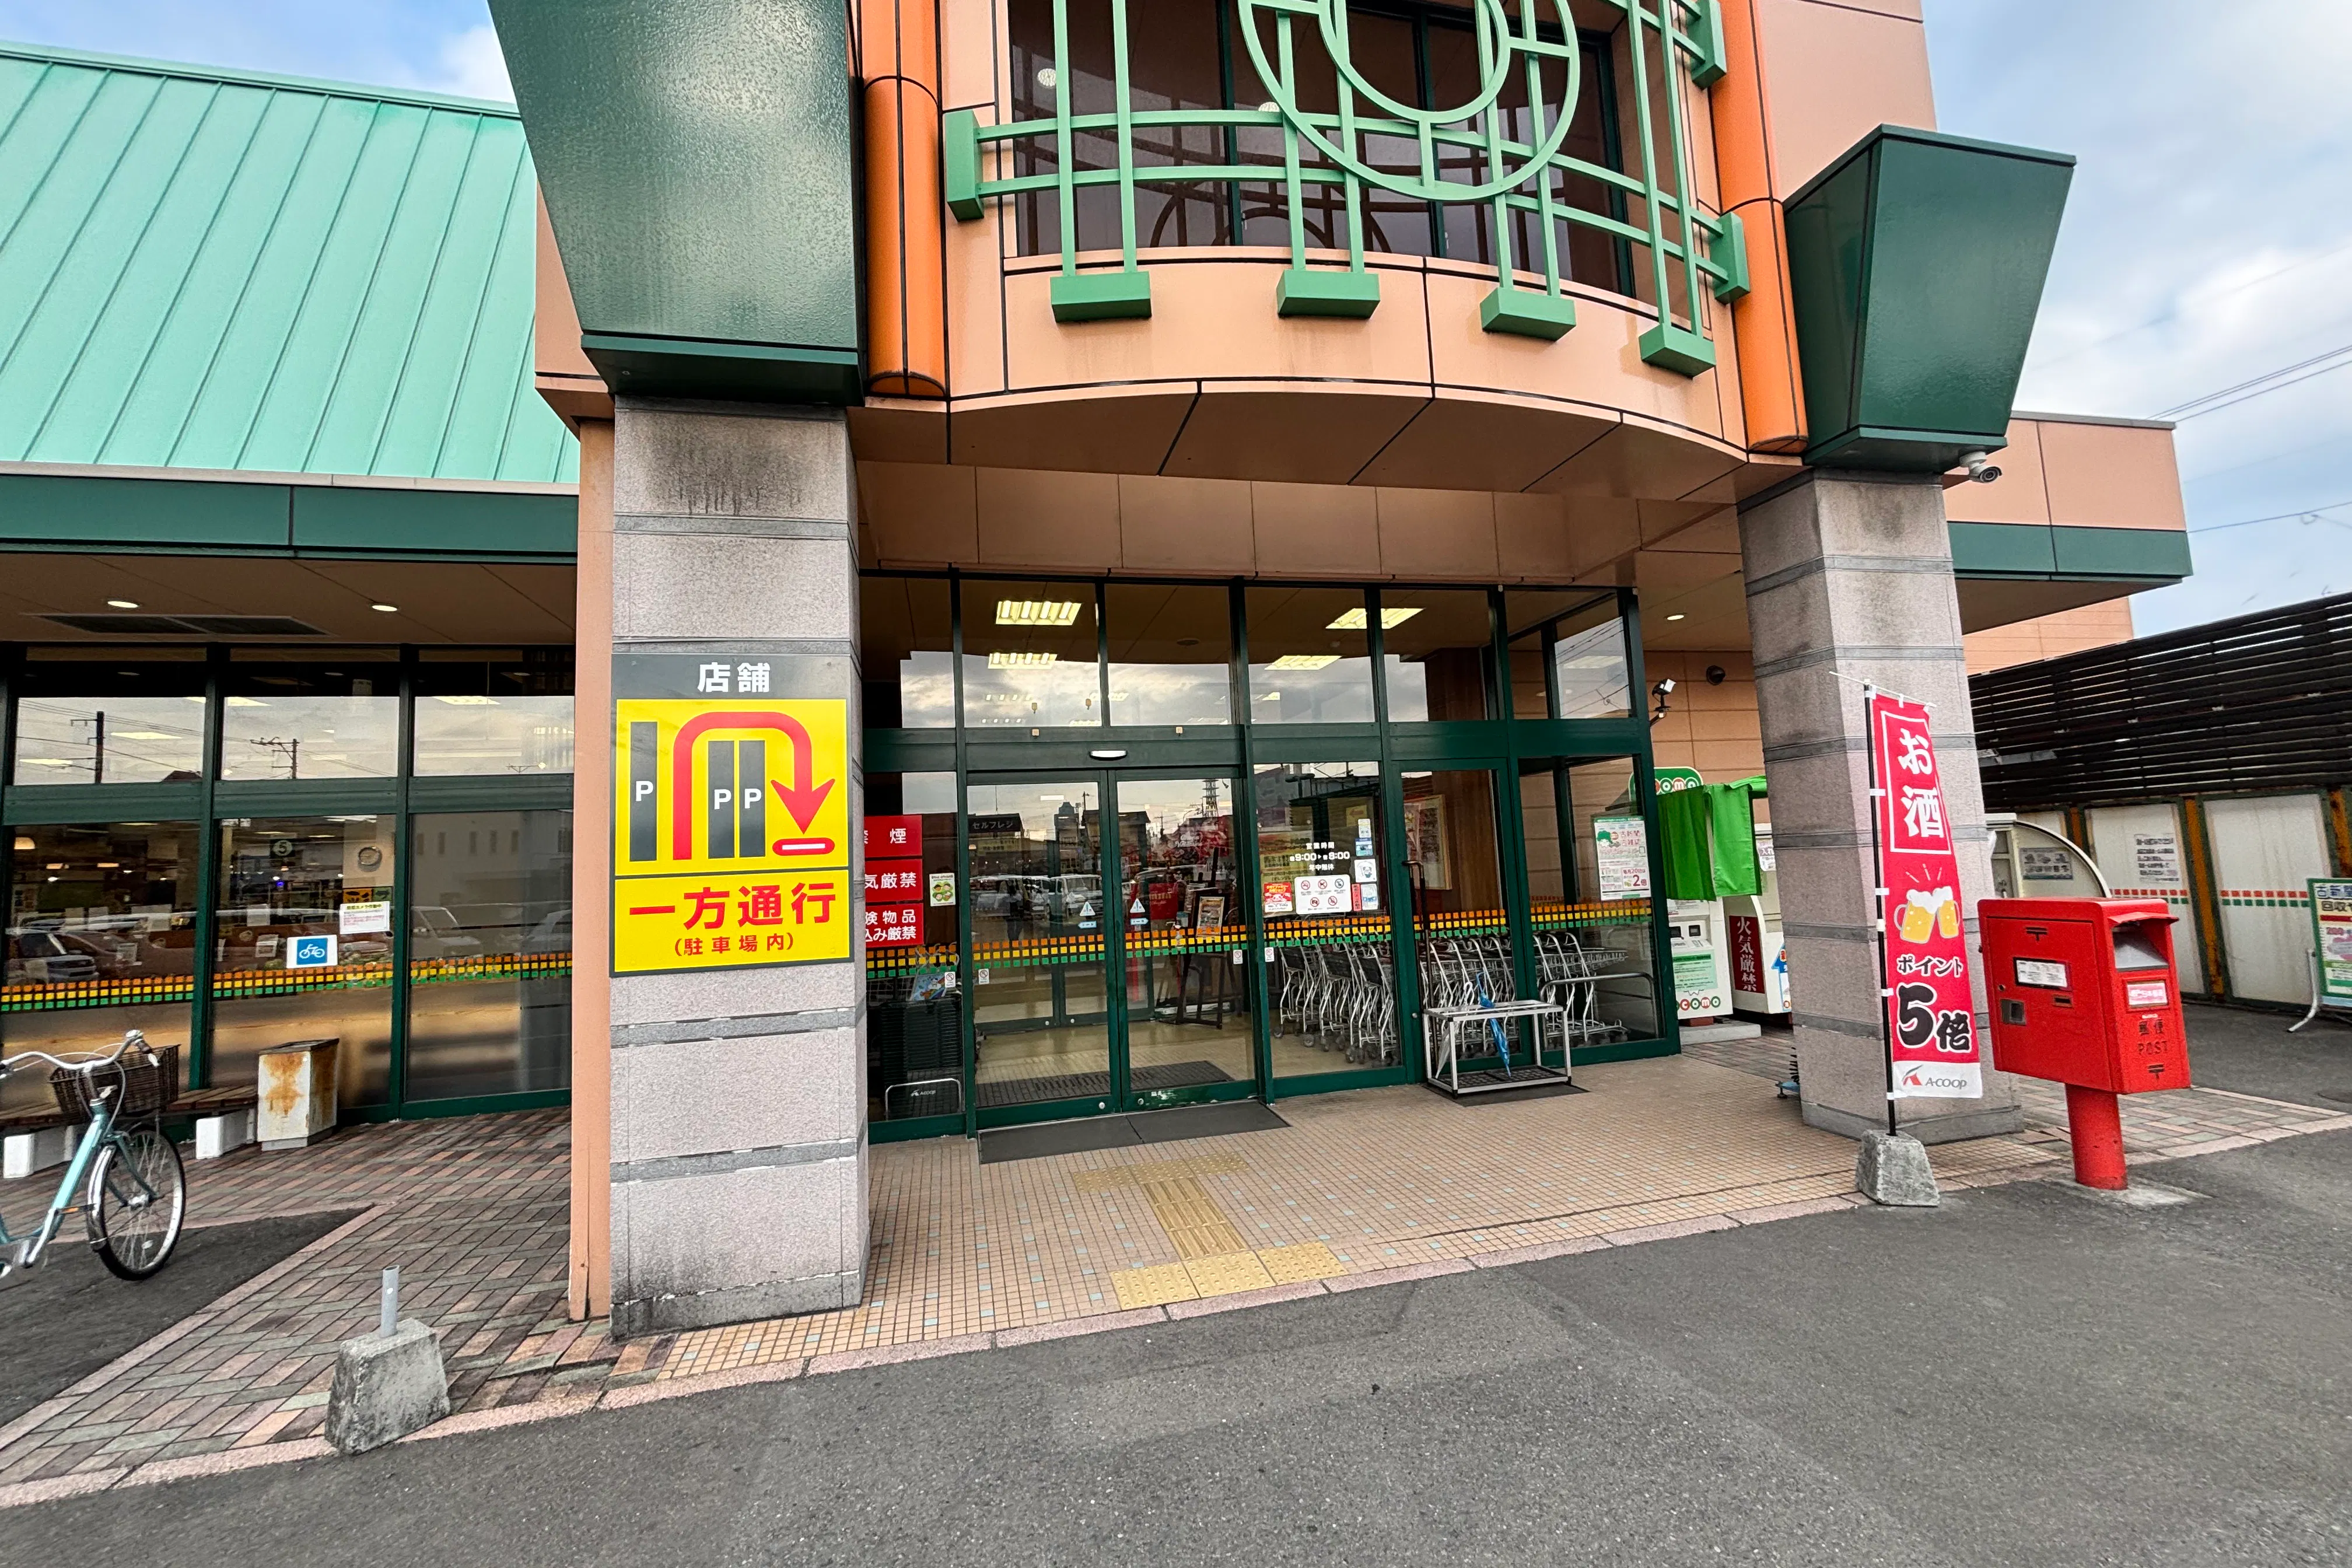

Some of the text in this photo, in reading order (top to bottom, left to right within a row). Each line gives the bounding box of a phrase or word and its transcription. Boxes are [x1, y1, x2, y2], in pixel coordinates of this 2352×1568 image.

[697, 662, 771, 692] 店舗
[635, 780, 654, 802] P
[1898, 728, 1944, 838] お酒
[713, 789, 732, 810] P
[744, 788, 762, 809] P
[972, 820, 1013, 829] セルフレジ
[629, 883, 836, 930] 一方通行
[1737, 916, 1757, 992] 火気厳禁
[1898, 955, 1962, 975] ポイント
[1898, 984, 1971, 1050] 5倍
[2138, 1041, 2167, 1055] POST
